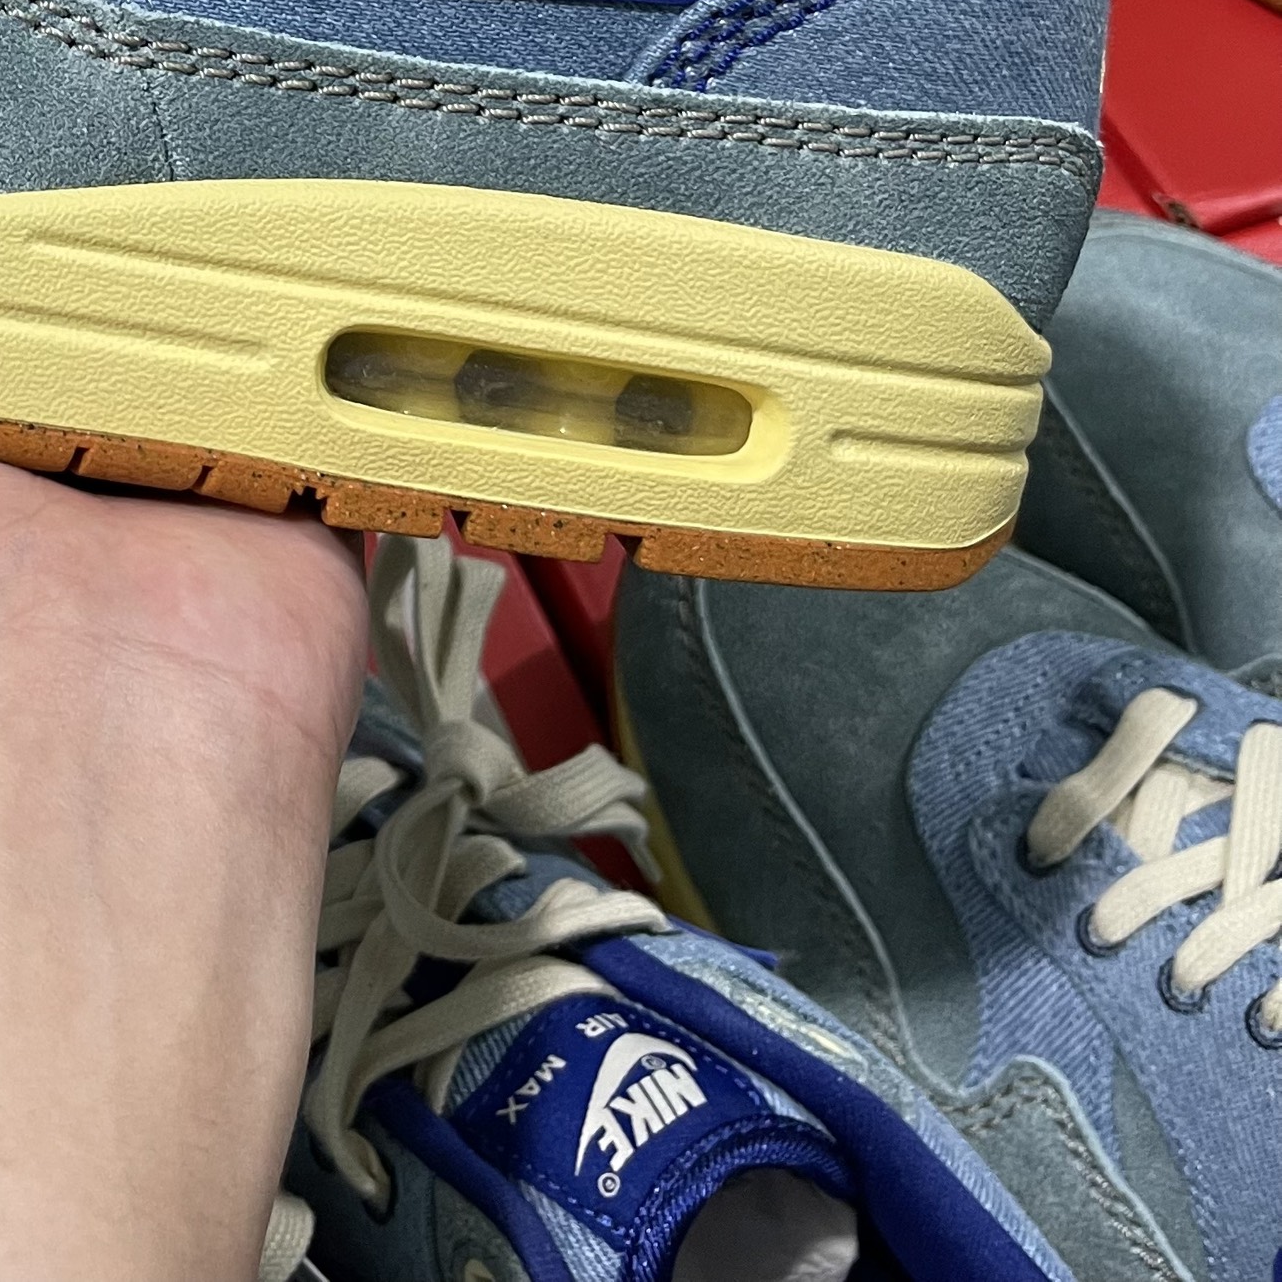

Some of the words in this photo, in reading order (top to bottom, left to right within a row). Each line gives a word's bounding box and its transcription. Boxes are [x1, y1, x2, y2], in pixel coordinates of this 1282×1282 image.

[575, 1012, 629, 1038] AIR
[495, 1053, 567, 1125] MAX
[598, 1063, 708, 1172] NIKE
